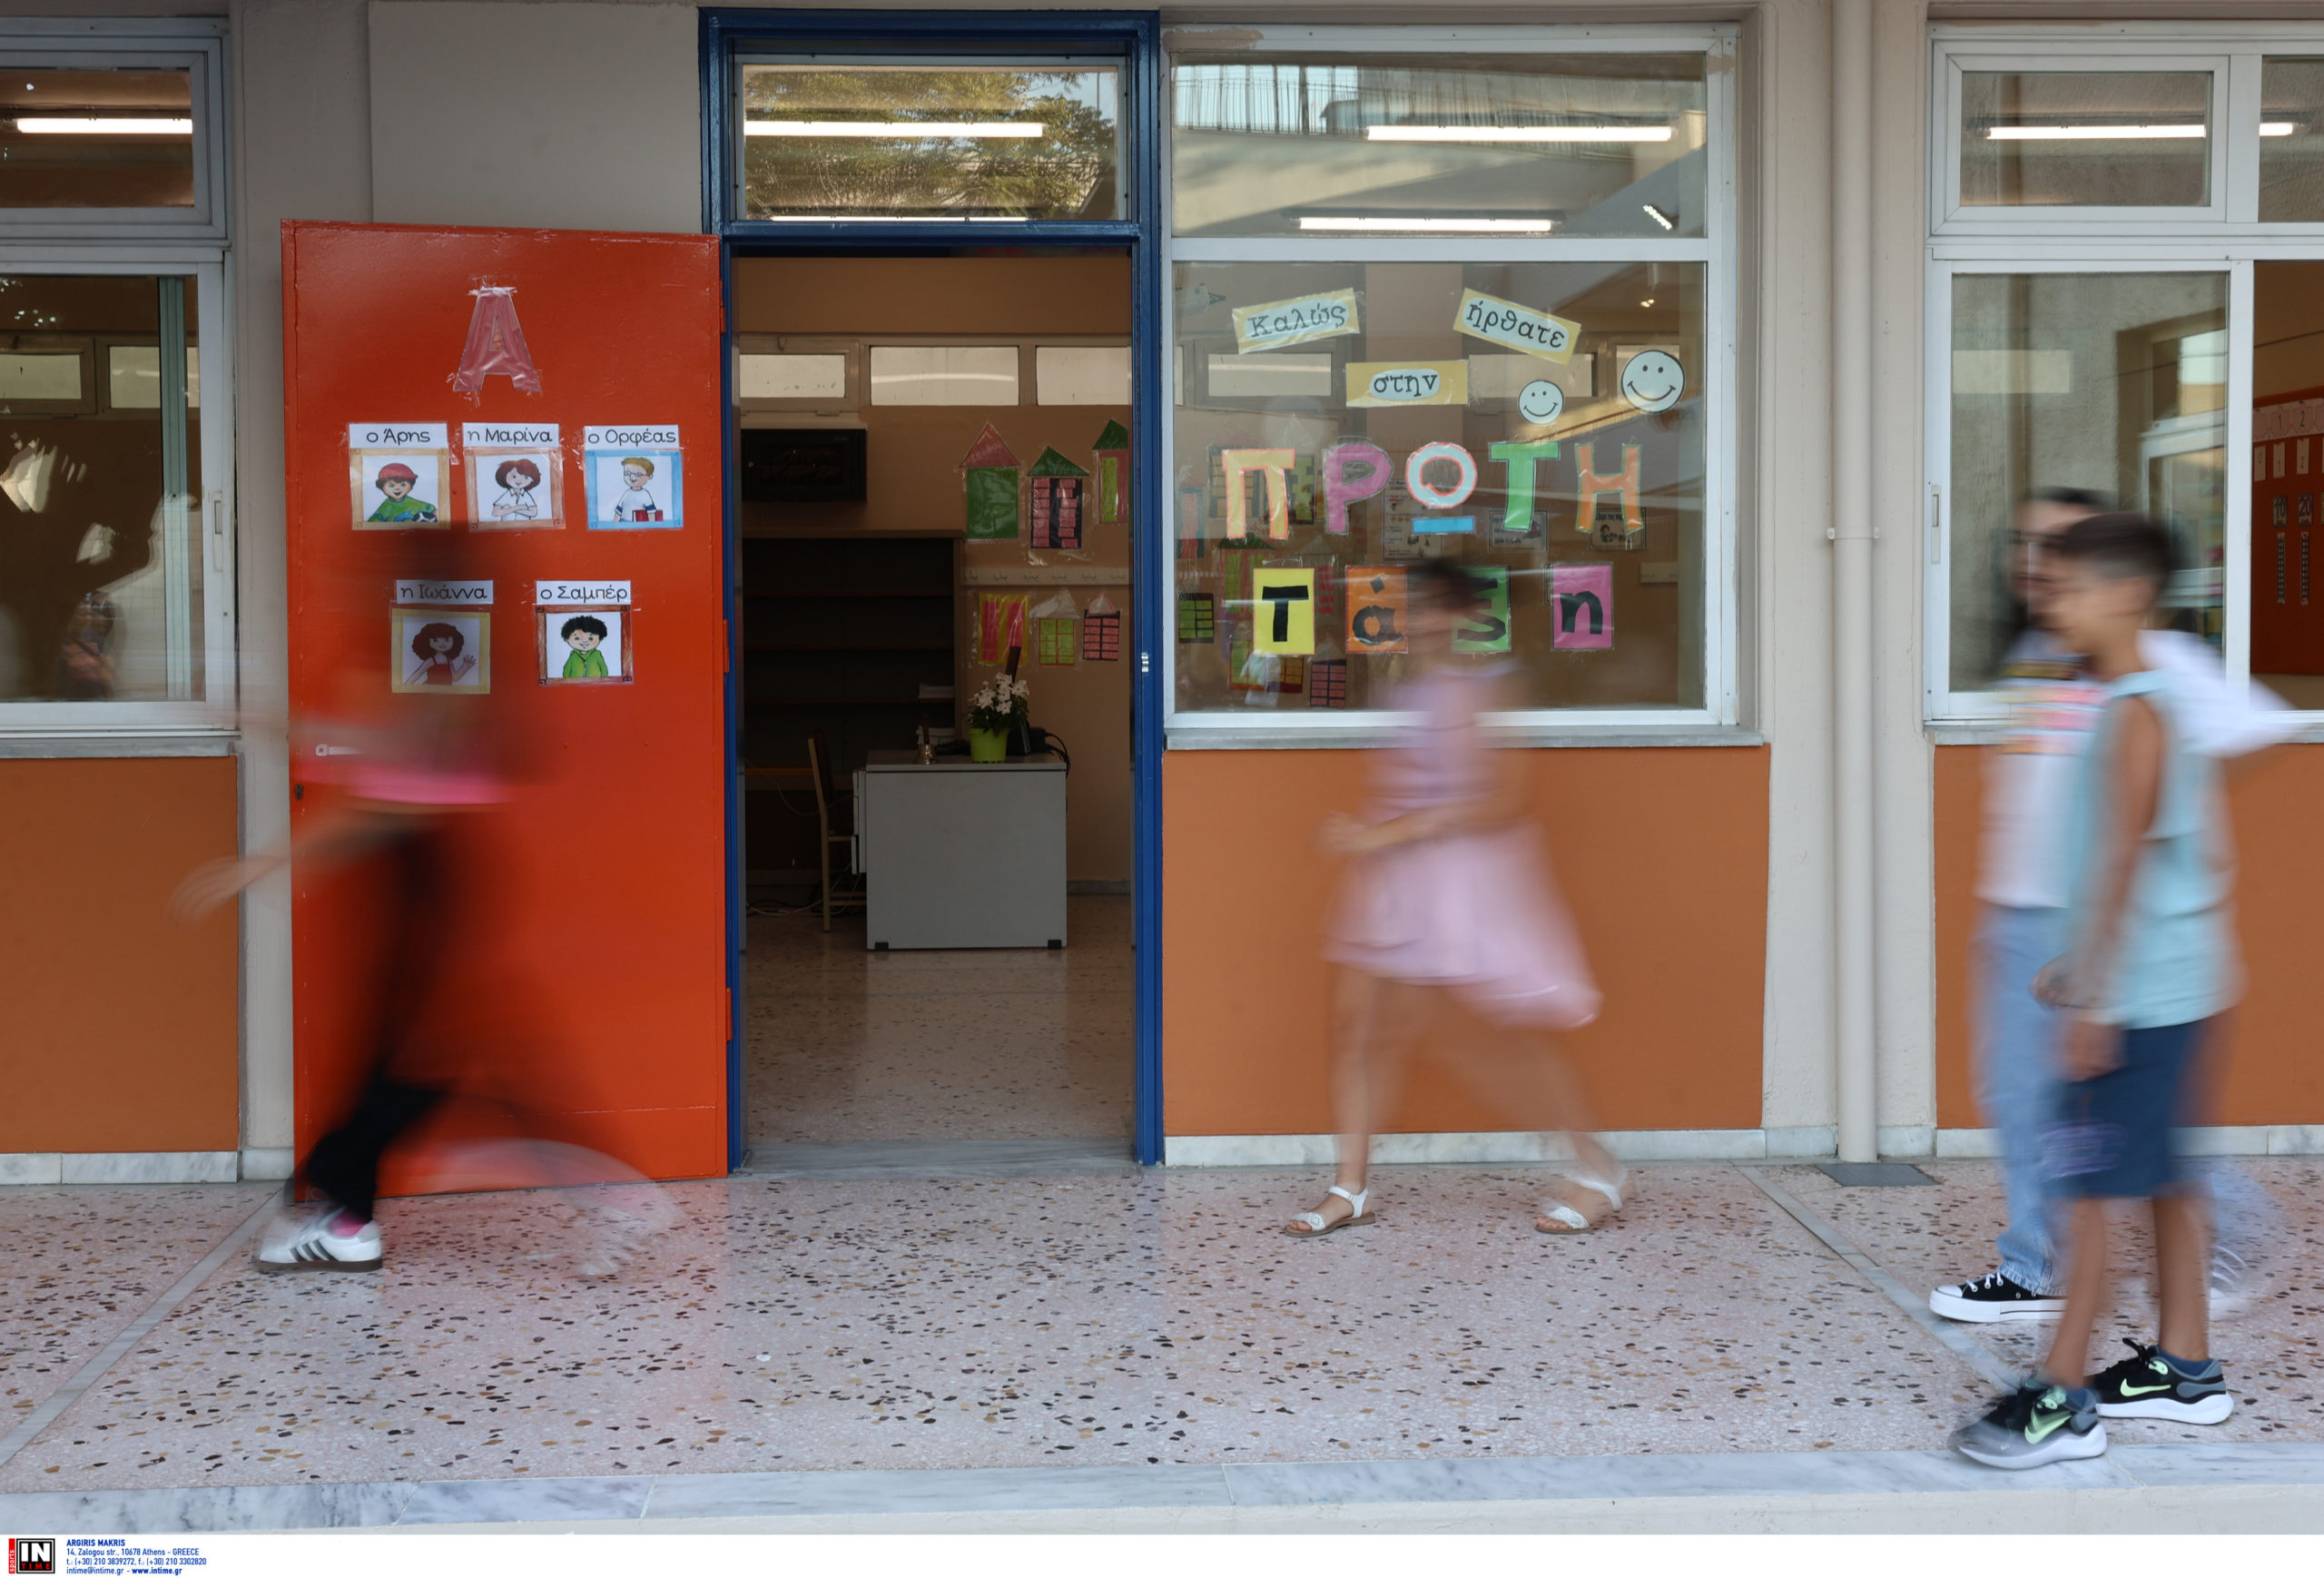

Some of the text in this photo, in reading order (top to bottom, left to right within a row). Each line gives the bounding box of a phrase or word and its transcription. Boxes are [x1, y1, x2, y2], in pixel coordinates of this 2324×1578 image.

[1466, 301, 1565, 349] ήρθατε
[1373, 373, 1439, 398] στην
[366, 428, 431, 446] ο Άρης
[485, 427, 553, 446] Μαρίνα
[587, 428, 676, 448] ο Ορφέας
[418, 584, 487, 600] Ιωάννα
[540, 585, 628, 603] ο Σαμπέρ
